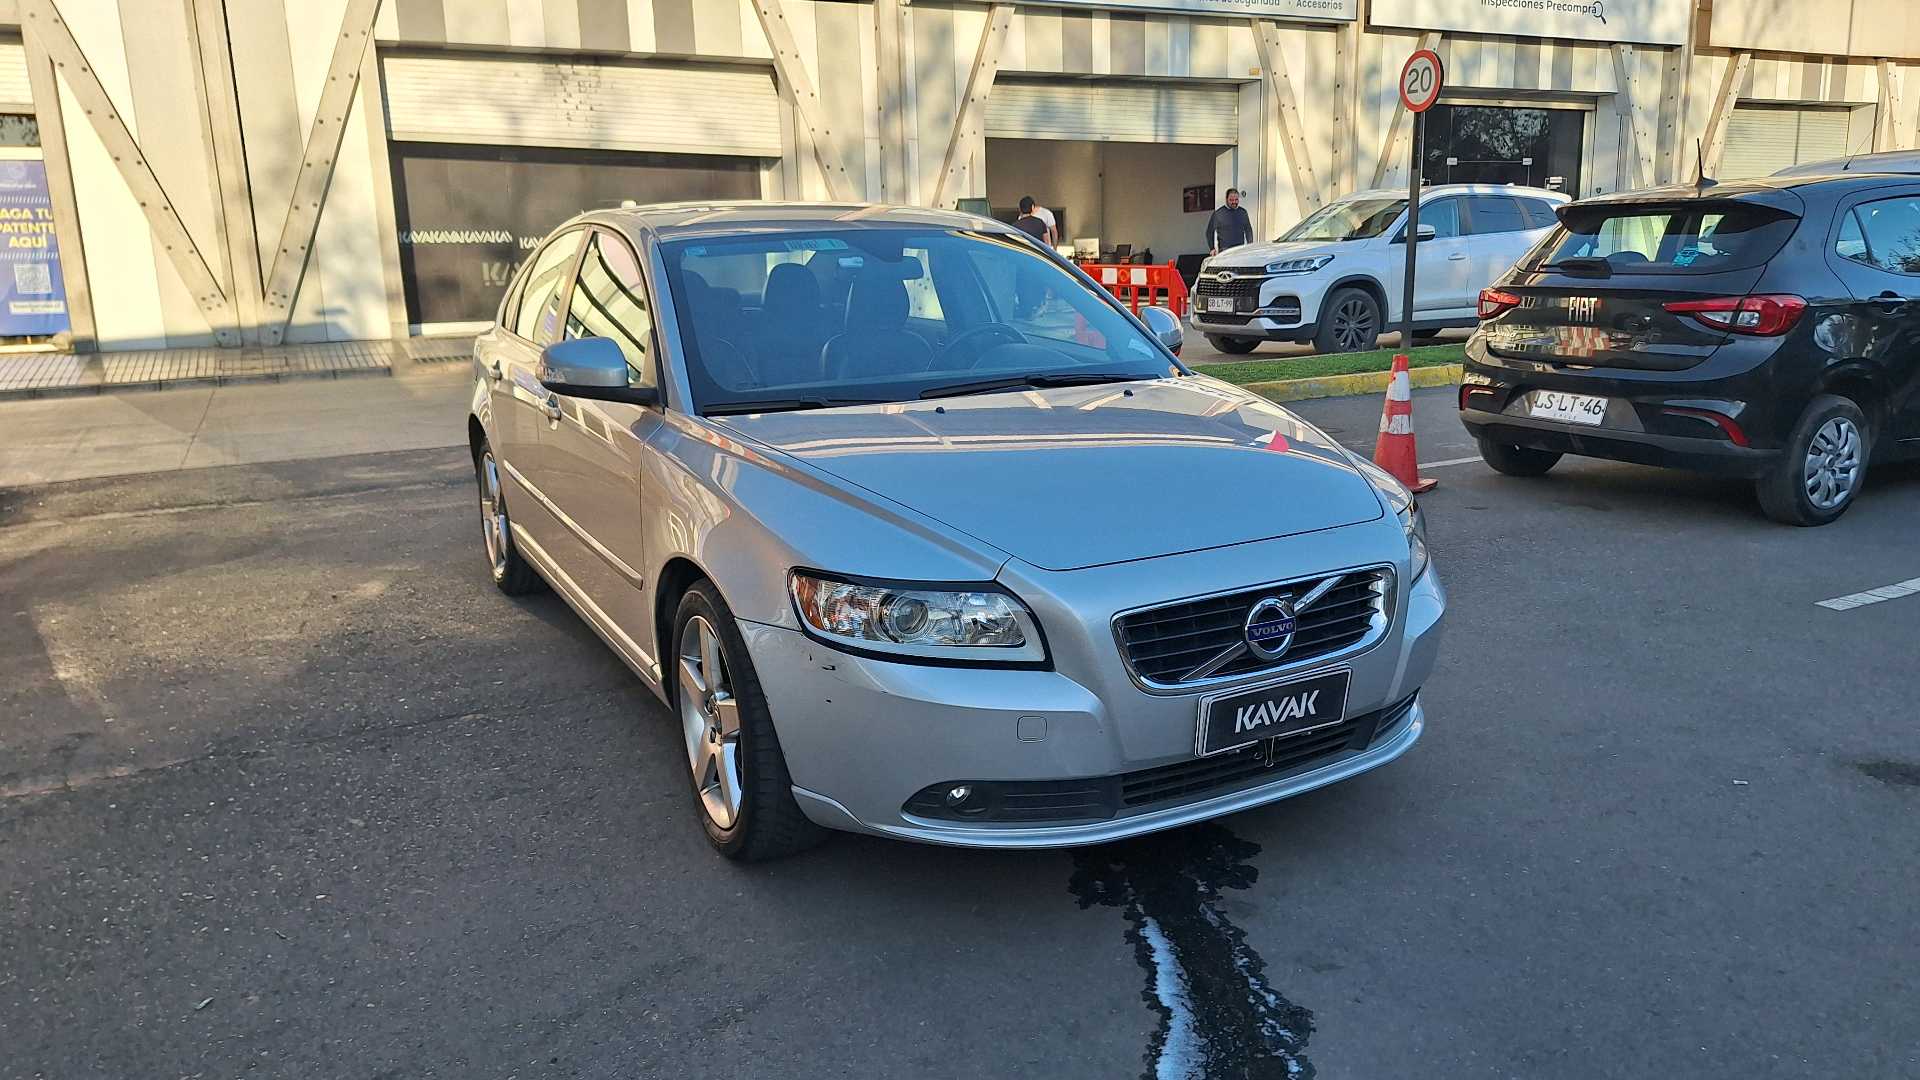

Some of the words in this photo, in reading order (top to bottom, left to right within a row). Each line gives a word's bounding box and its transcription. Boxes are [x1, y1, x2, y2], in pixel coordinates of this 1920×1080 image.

[1546, 0, 1597, 15] Precompra
[1407, 66, 1432, 94] 20
[0, 208, 33, 220] AGA
[1568, 296, 1598, 322] FIAT
[1251, 621, 1294, 637] VOLVO
[1234, 689, 1320, 734] KAVAK
